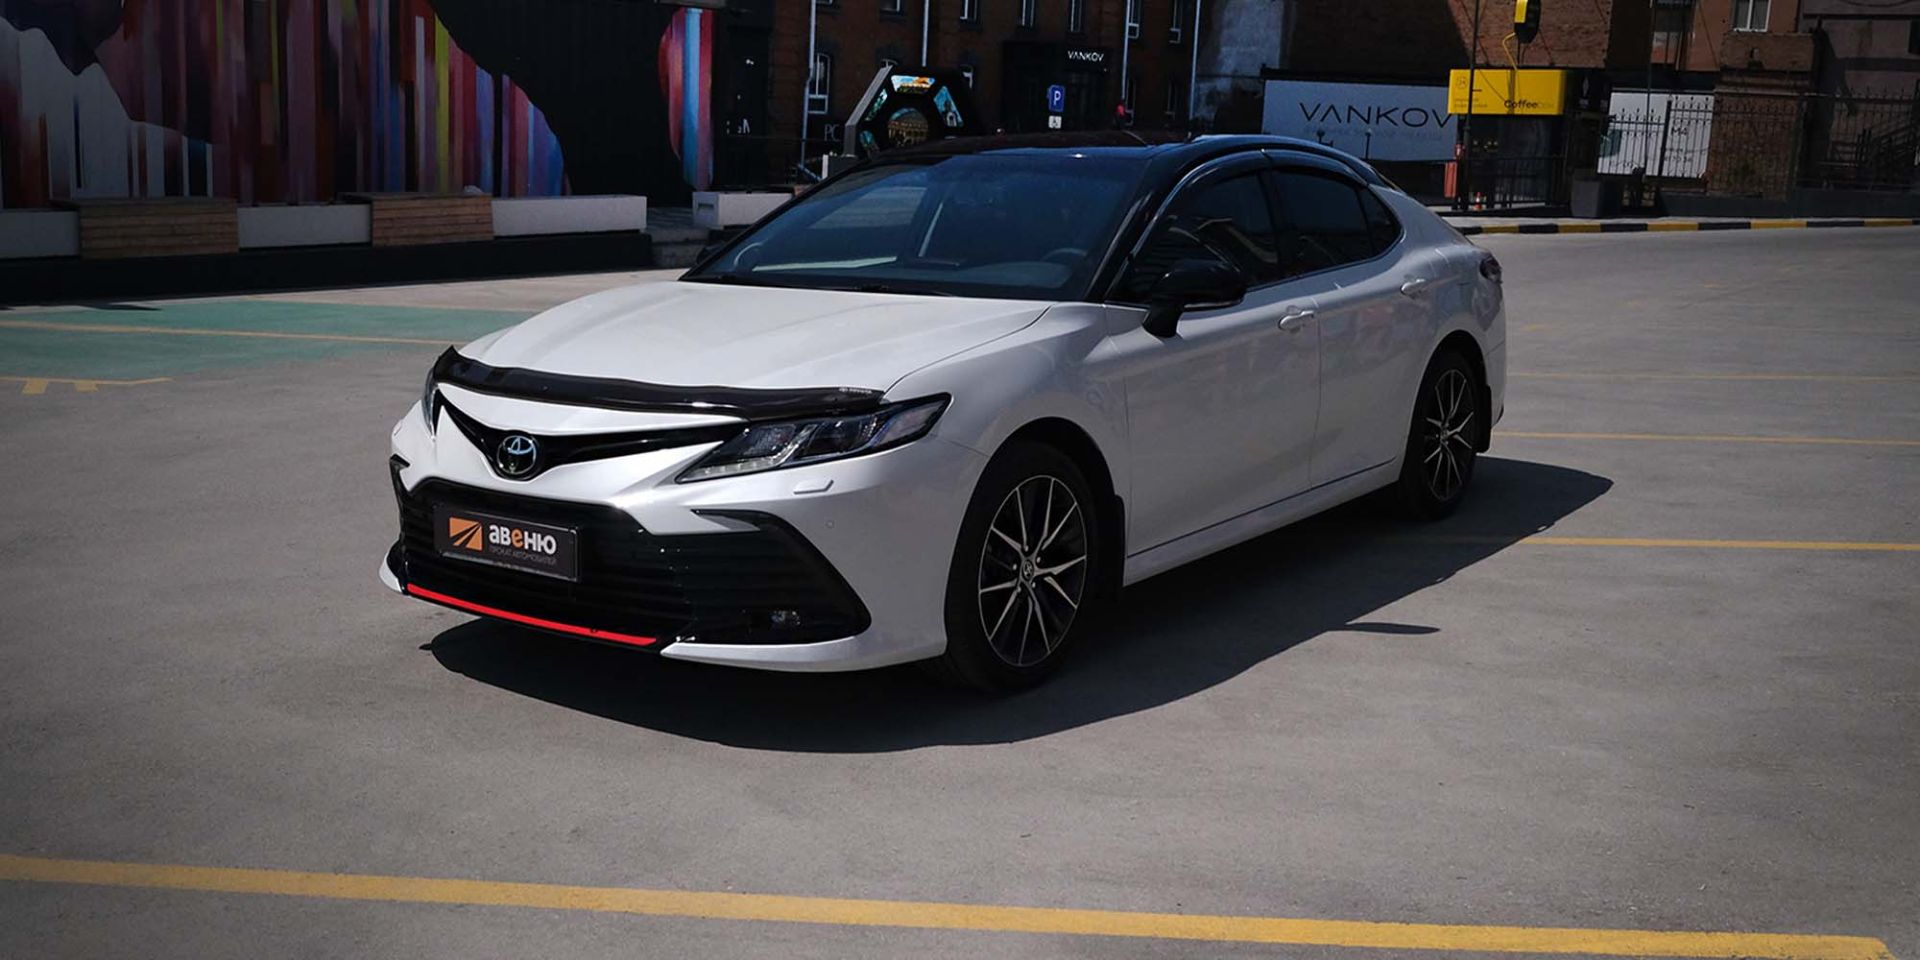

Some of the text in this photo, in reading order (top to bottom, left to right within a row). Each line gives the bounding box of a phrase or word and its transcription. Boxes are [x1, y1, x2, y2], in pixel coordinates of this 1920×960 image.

[1067, 50, 1105, 62] VANKOV
[1053, 90, 1062, 106] P
[1299, 102, 1452, 128] VANKOV
